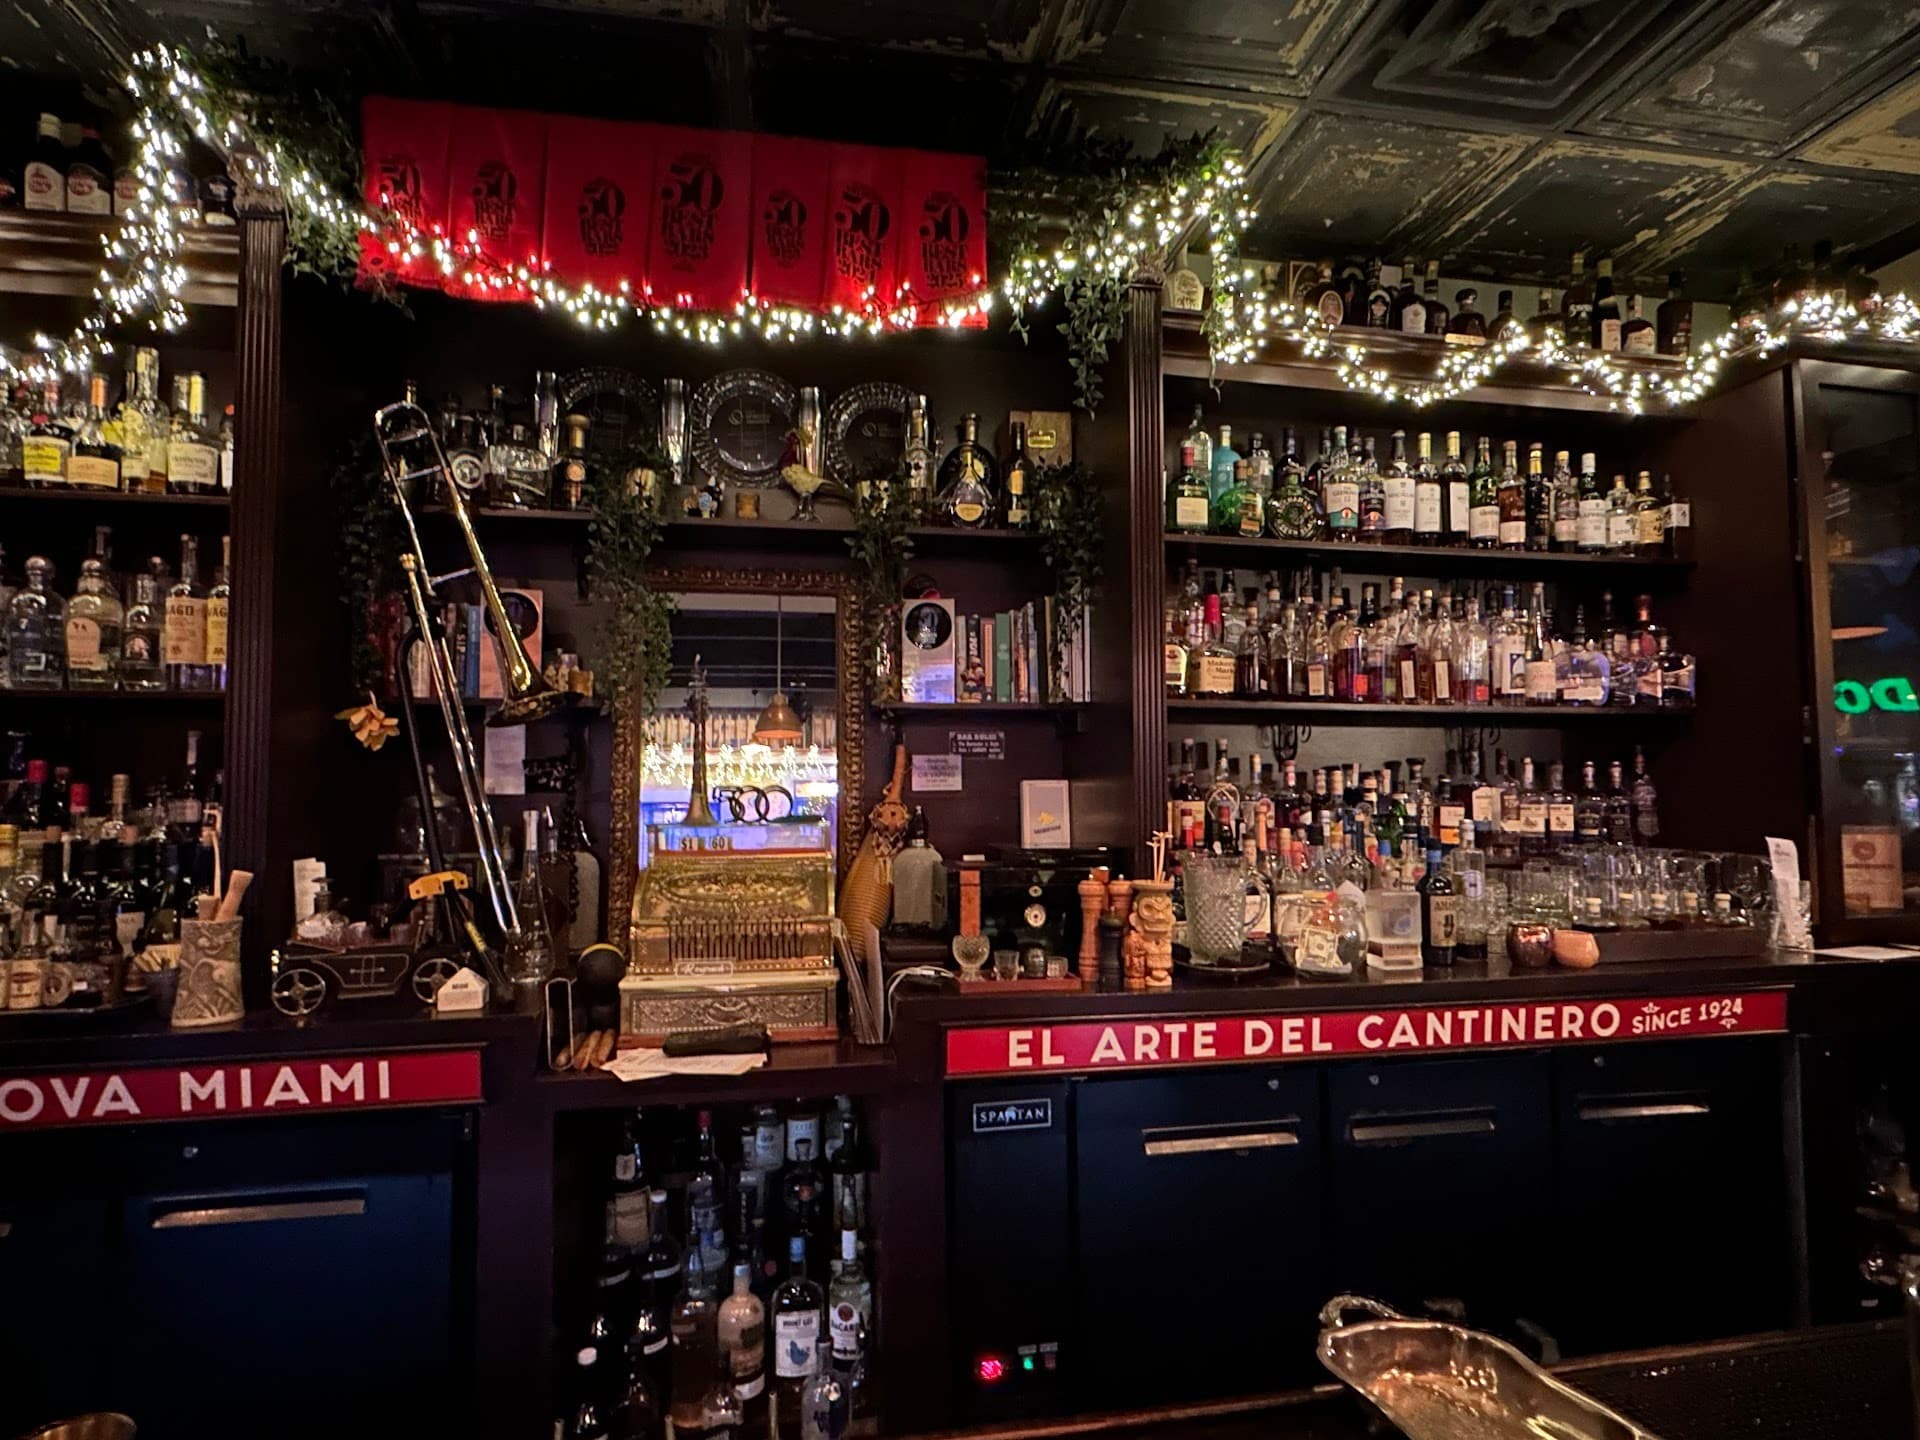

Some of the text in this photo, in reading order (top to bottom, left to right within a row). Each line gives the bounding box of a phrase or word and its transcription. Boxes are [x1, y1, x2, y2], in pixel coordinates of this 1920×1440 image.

[1008, 1003, 1620, 1067] EL ARTE DEL CANTINERO
[1632, 997, 1743, 1035] SINCE 1924
[0, 1060, 391, 1122] OVA MIAMI
[979, 1107, 1045, 1123] SPARTAN
